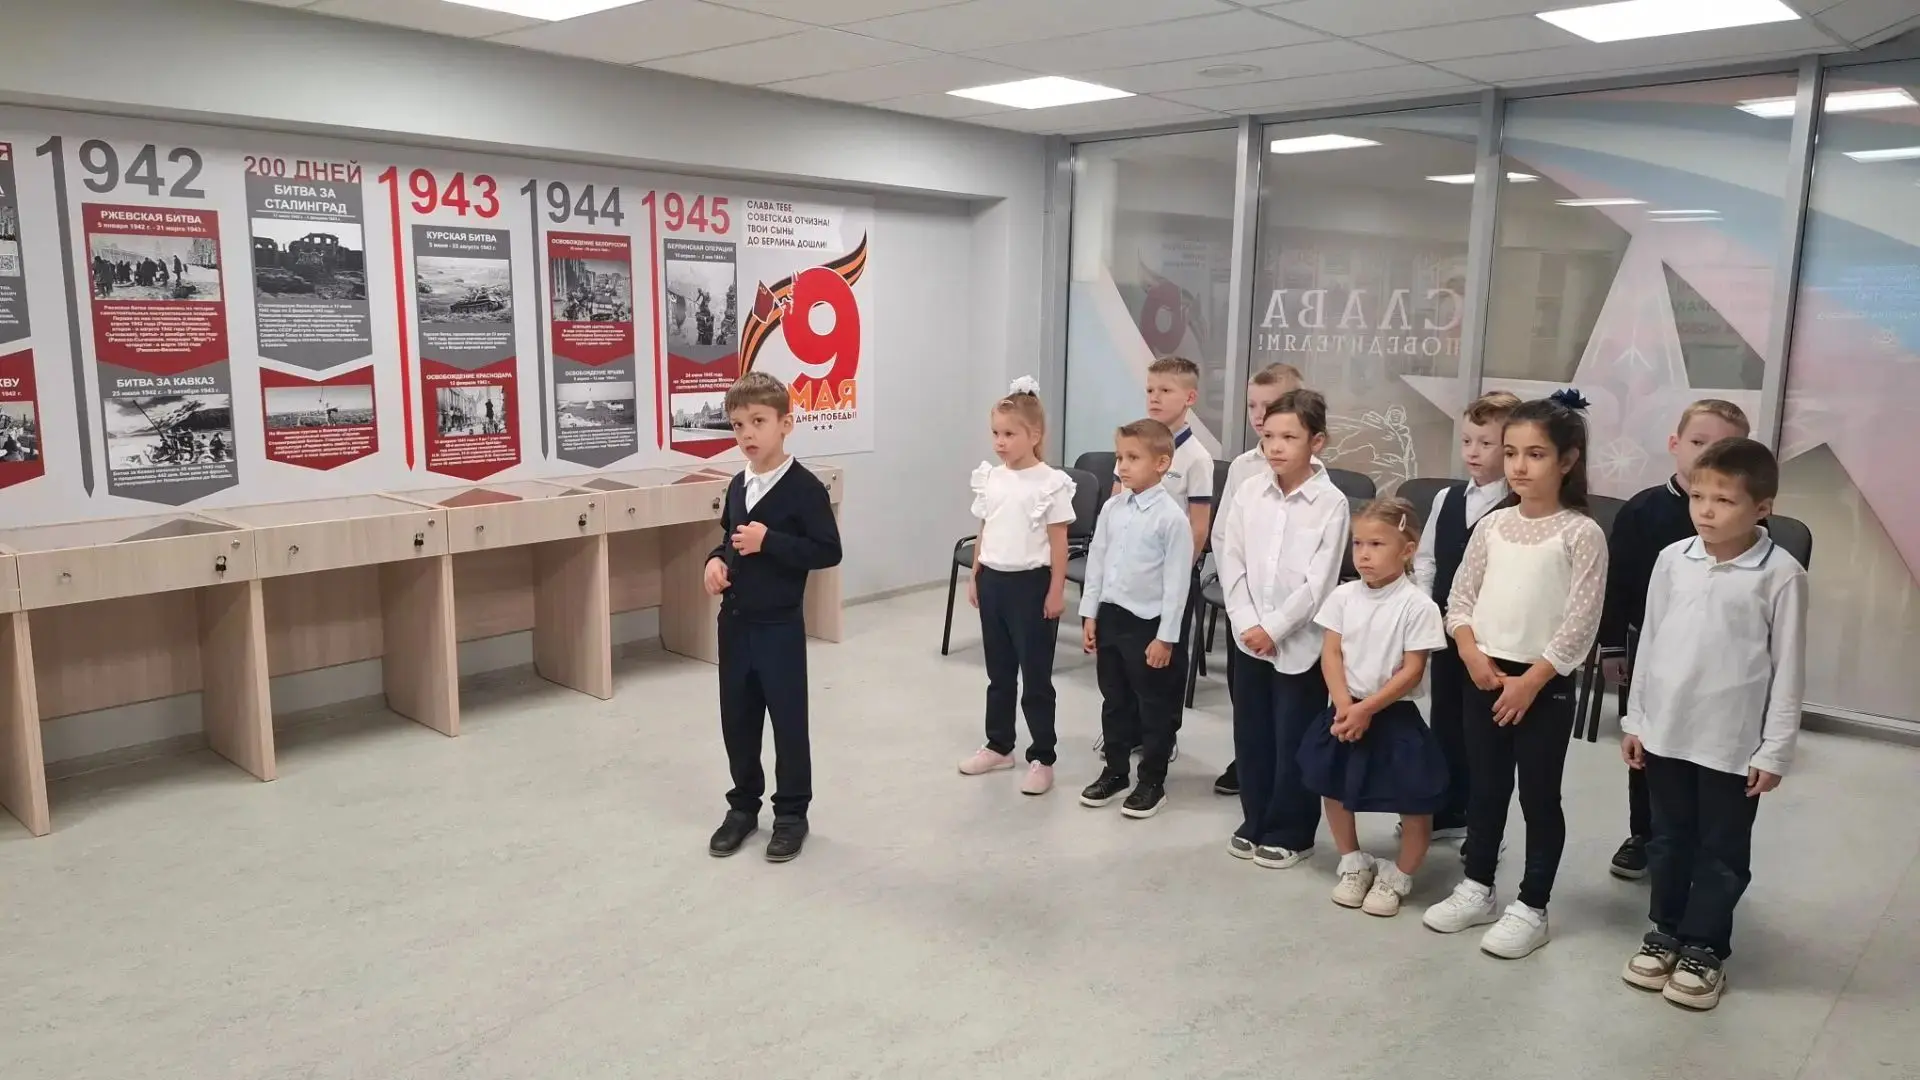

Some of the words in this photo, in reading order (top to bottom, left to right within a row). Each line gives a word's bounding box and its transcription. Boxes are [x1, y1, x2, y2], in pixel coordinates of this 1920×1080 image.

[244, 156, 285, 176] 200
[294, 159, 361, 183] ДНЕЙ
[274, 184, 317, 197] БИТВА
[320, 188, 336, 198] ЗА
[265, 198, 347, 214] СТАЛИНГРАД
[747, 200, 774, 210] СЛАВА
[100, 210, 163, 222] РЖЕВСКАЯ
[166, 214, 202, 224] БИТВА
[747, 212, 793, 223] СОВЕТСКАЯ
[795, 216, 830, 226] ОТЧИЗНА!
[747, 224, 768, 233] ТВОИ
[770, 226, 794, 235] СЫНЫ
[426, 231, 466, 241] КУРСКАЯ
[468, 233, 497, 242] БИТВА
[551, 238, 594, 247] ОСВОБОЖДЕНИЕ
[747, 236, 759, 245] ДО
[761, 237, 795, 247] БЕРЛИНА
[797, 240, 827, 248] ДОШЛИ!
[667, 243, 704, 251] БЕРЛИНСКАЯ
[704, 245, 734, 253] ОПЕРАЦИЯ
[781, 267, 860, 404] 9
[116, 379, 154, 388] БИТВА
[156, 378, 171, 386] ЗА
[173, 377, 215, 386] КАВКАЗ
[788, 379, 857, 413] МАЯ
[796, 413, 818, 423] ДНЕМ
